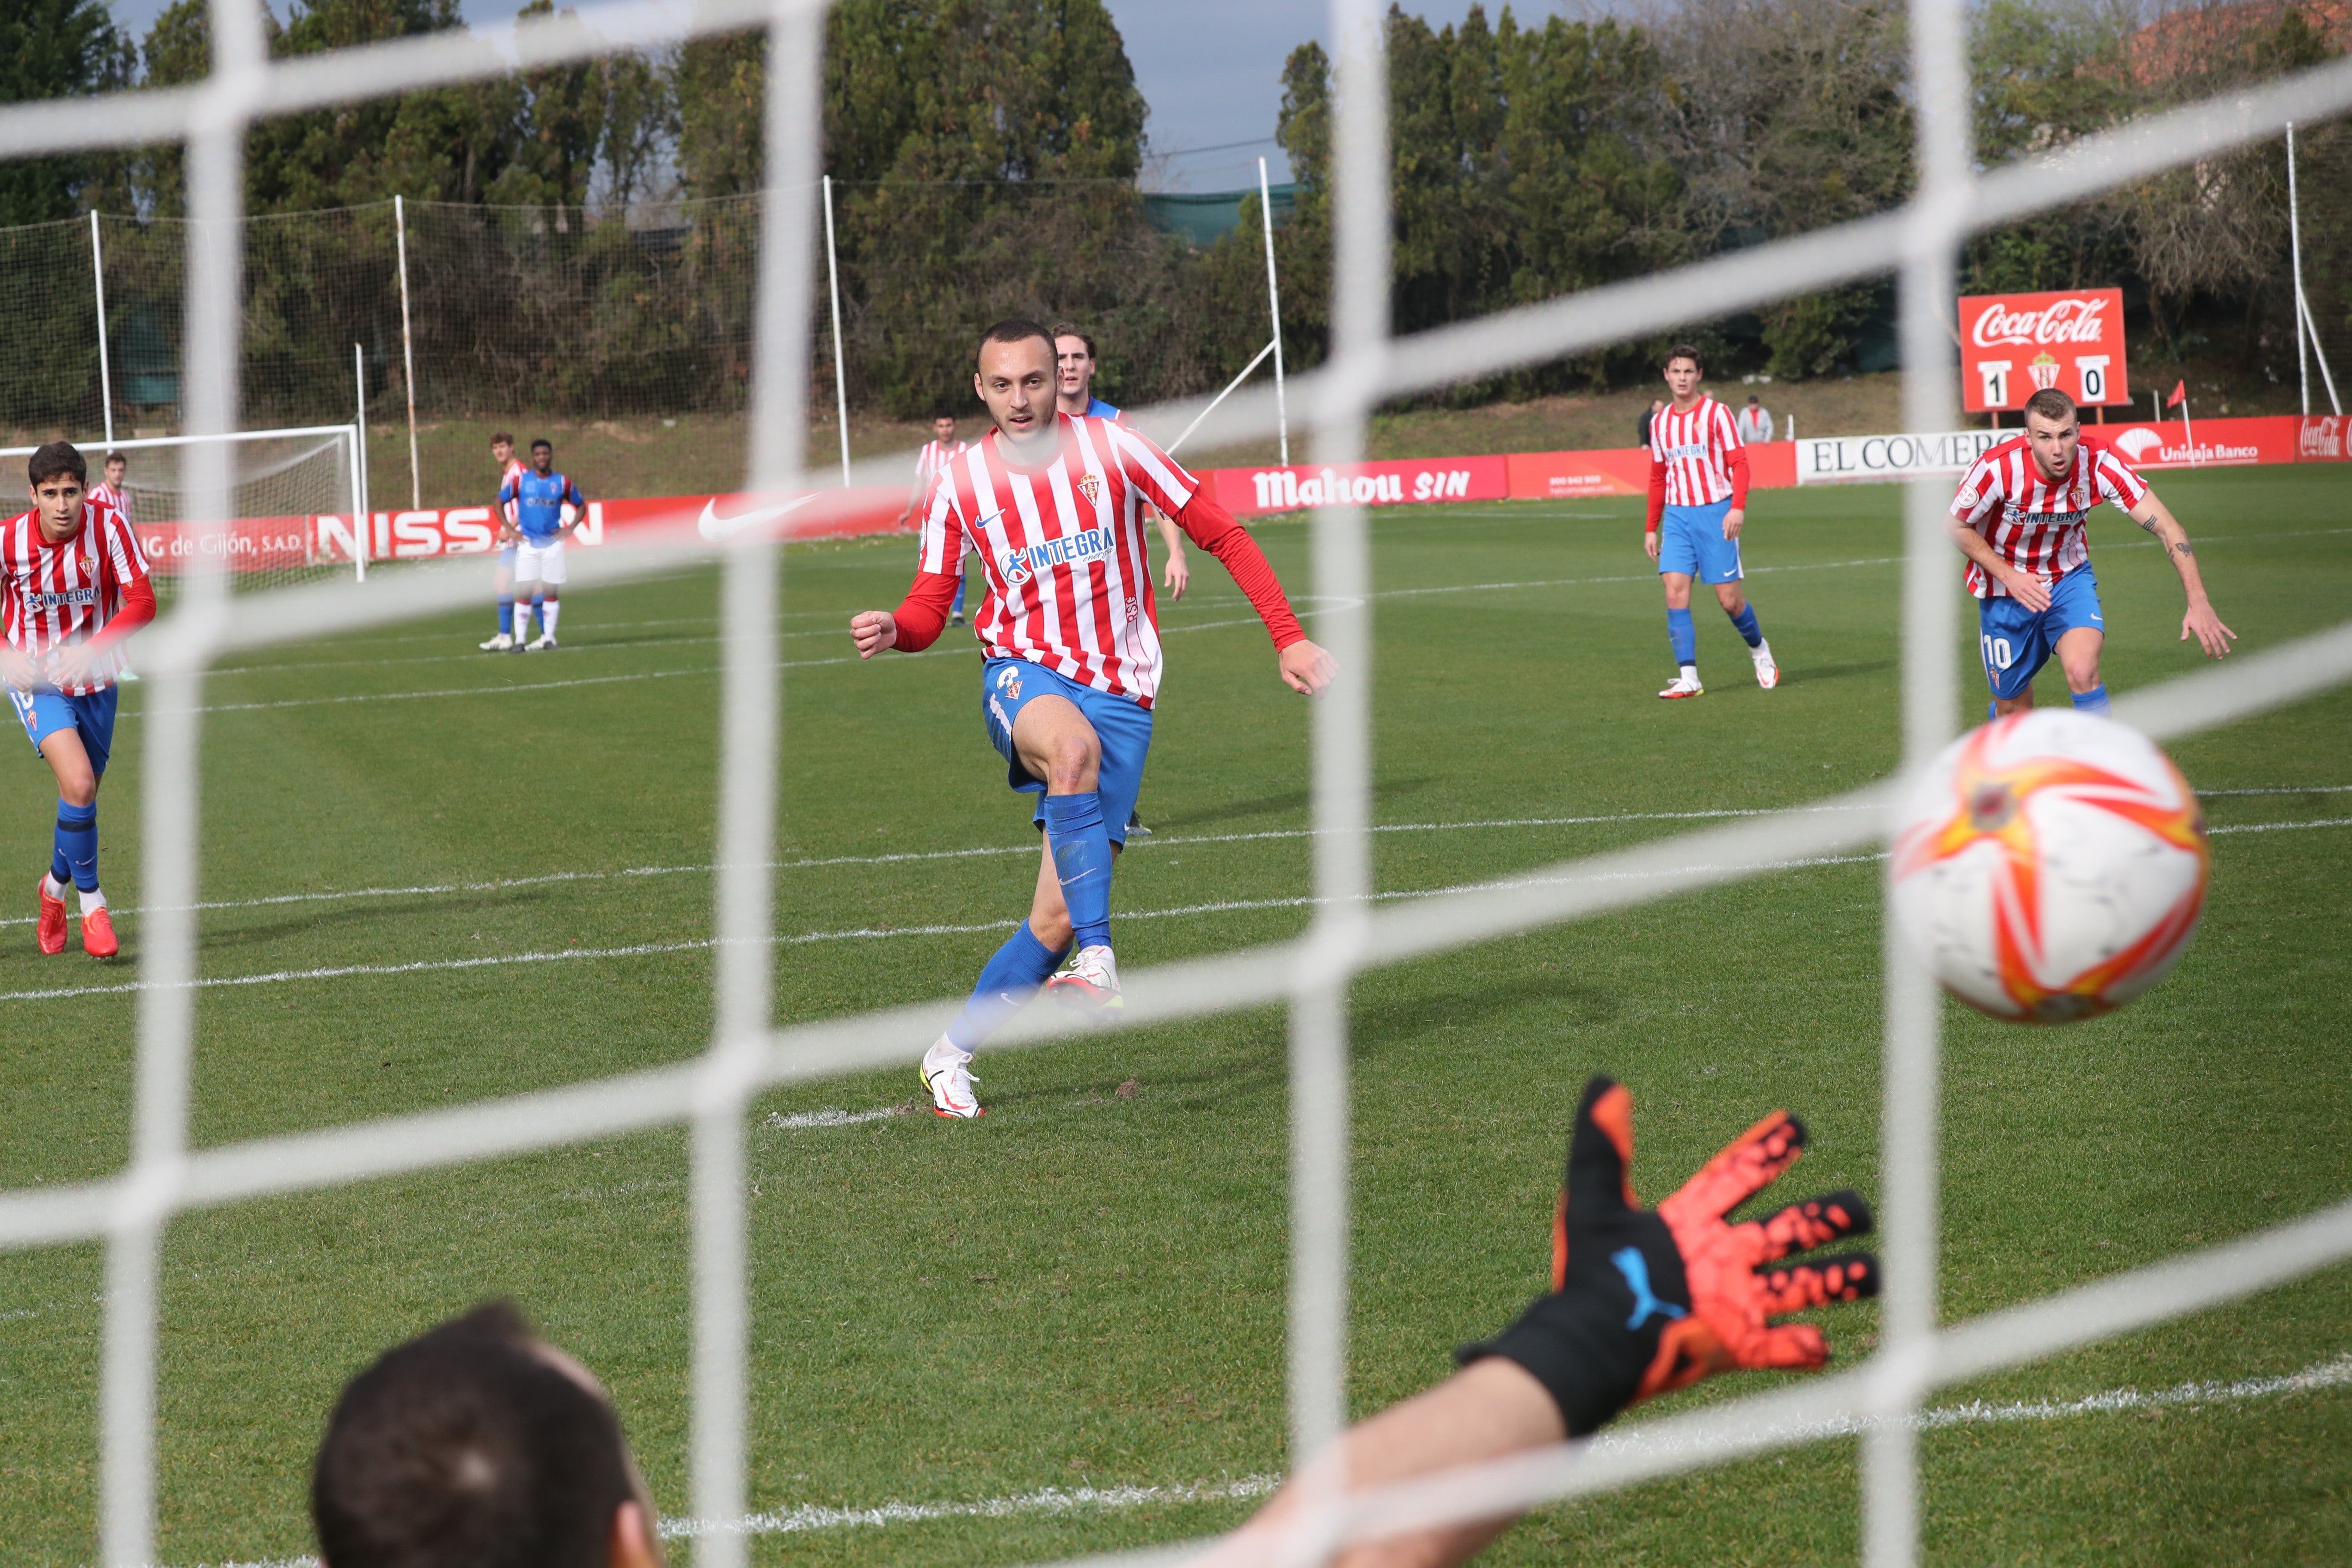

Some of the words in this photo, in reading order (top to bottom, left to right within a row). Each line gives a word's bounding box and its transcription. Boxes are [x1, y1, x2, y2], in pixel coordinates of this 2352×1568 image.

[1972, 298, 2110, 348] Coca-Cola
[1989, 374, 2000, 402] 1
[2086, 369, 2100, 395] 0
[1673, 444, 1708, 457] INTEGRA
[2300, 416, 2341, 456] Coca-Cola
[1813, 440, 1856, 472] EL
[2159, 442, 2214, 463] Unicaja
[2215, 444, 2258, 459] Banco
[1252, 467, 1404, 508] Mahou
[1413, 471, 1470, 500] SIN
[317, 502, 602, 560] NISSN
[2026, 509, 2085, 524] INTEGRA
[170, 534, 193, 556] de
[199, 531, 258, 560] Gijón,
[261, 534, 305, 552] S.A.D.
[1029, 527, 1114, 569] INTEGRA
[43, 586, 101, 606] INTEGRA
[1984, 634, 2012, 669] 10
